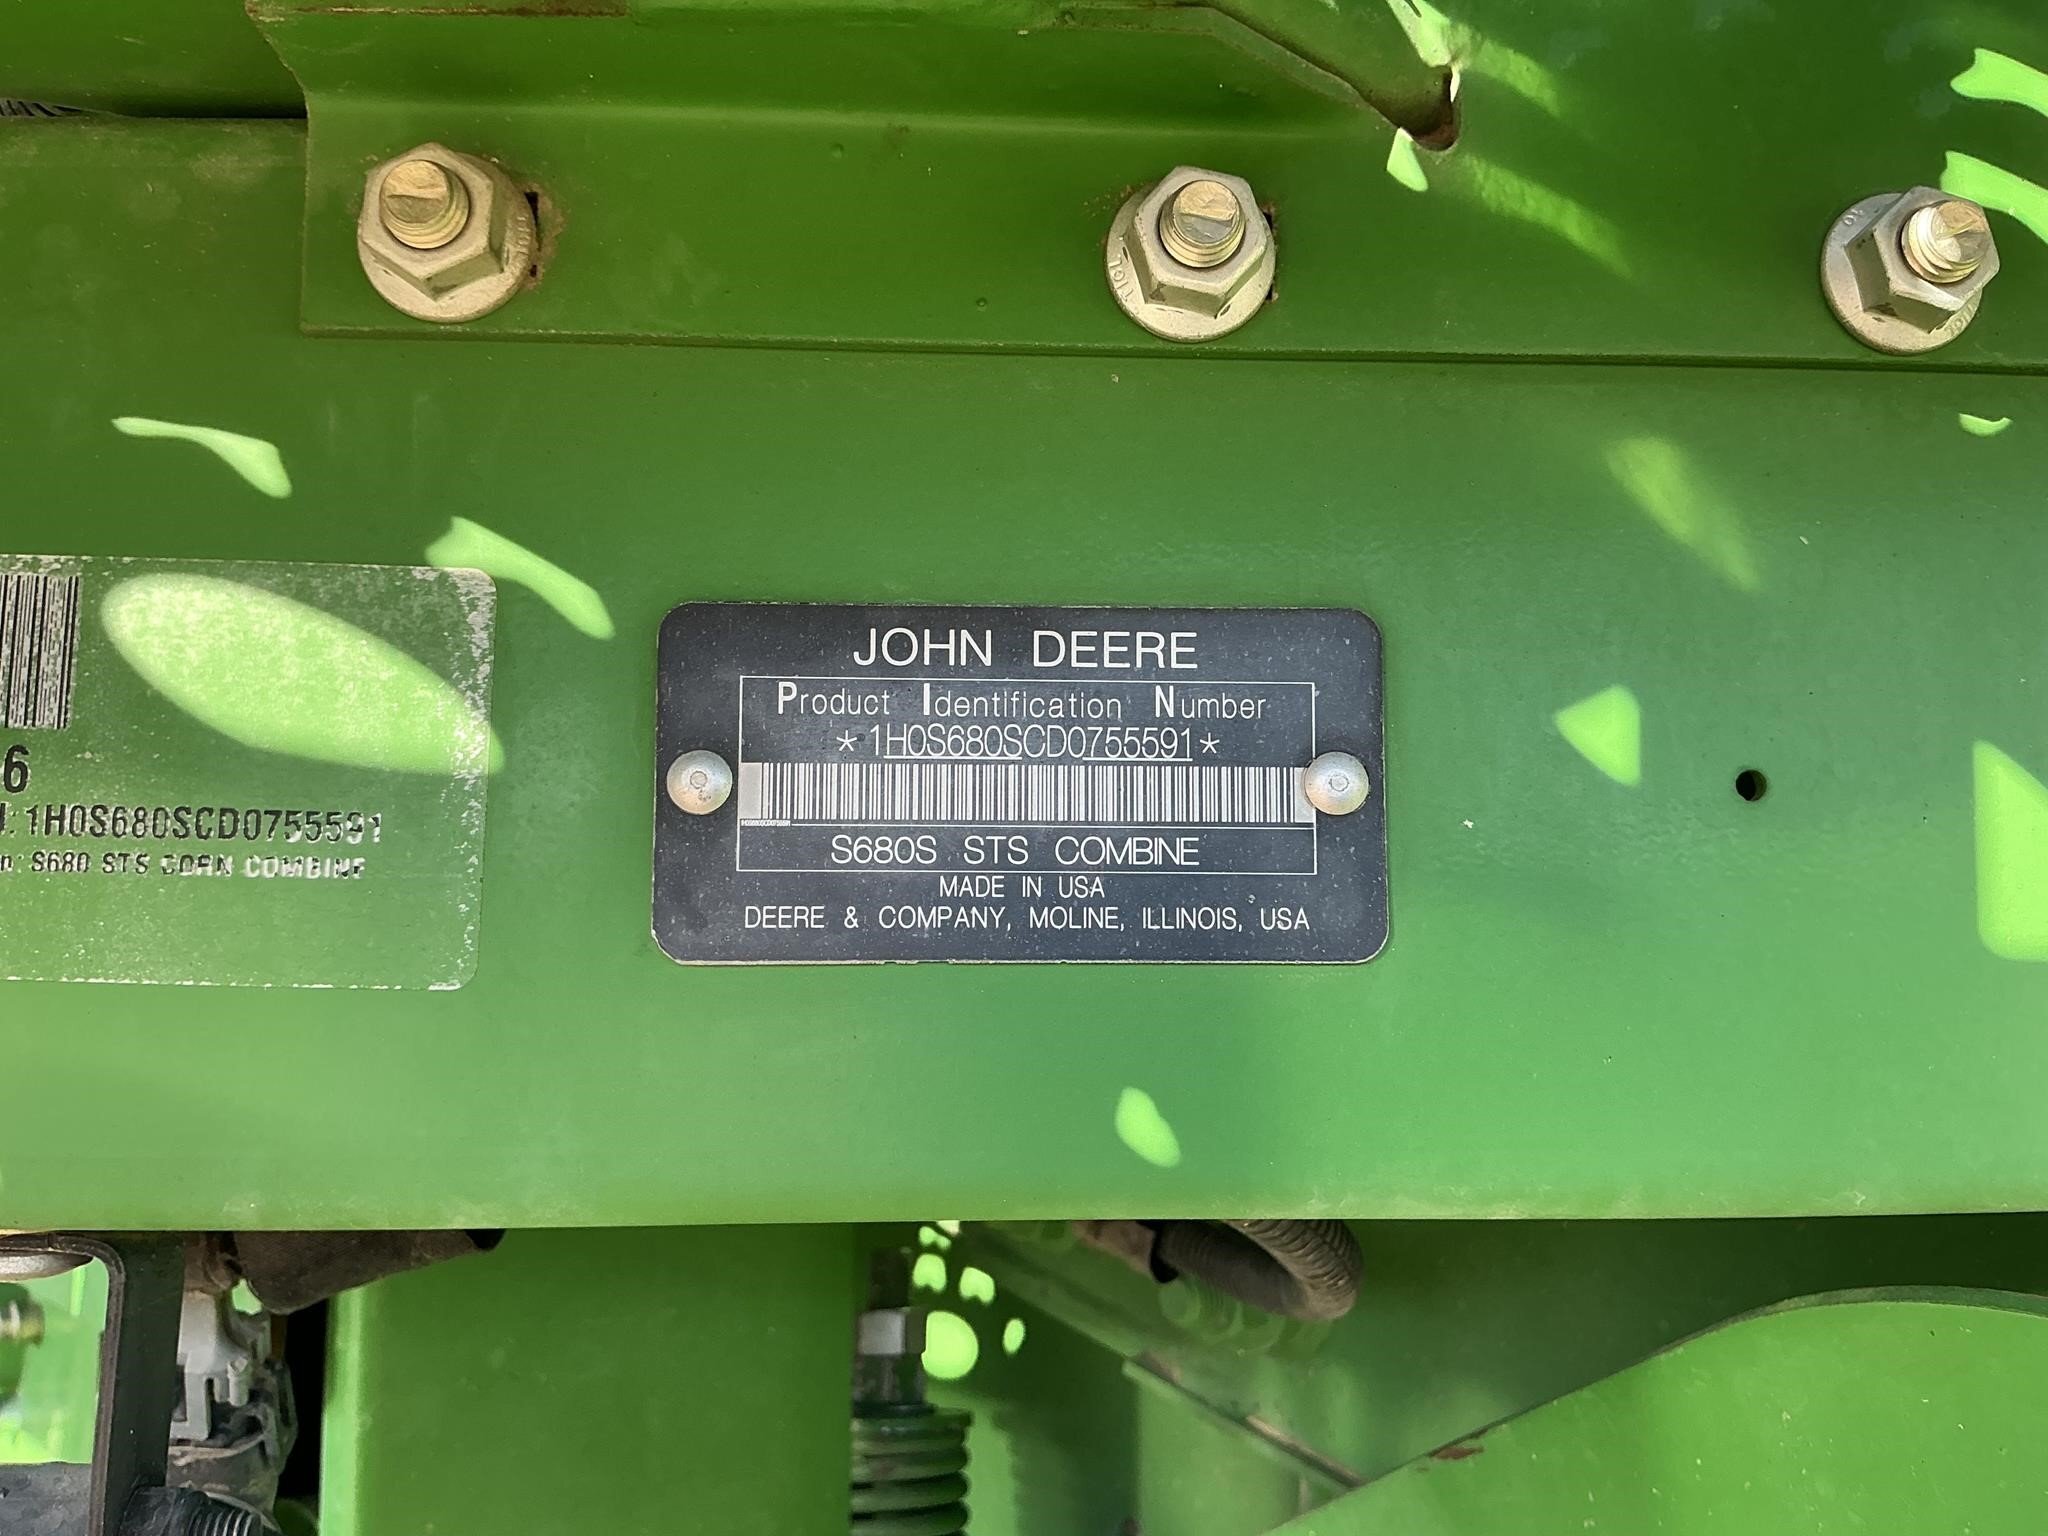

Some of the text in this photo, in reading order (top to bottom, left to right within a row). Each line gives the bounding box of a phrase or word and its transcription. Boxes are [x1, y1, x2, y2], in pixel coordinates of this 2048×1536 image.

[853, 627, 1199, 669] JOHN DEERE
[777, 681, 1267, 719] Product Identification Number
[31, 851, 91, 873] S680
[102, 853, 149, 874] STS
[161, 854, 233, 876] CORN
[831, 834, 1200, 866] S680S STS COMBINE
[939, 875, 1105, 899] MADE IN USA
[744, 905, 1310, 932] DEERE & COMPANY, MOLINE, ILLINOIS, USA
